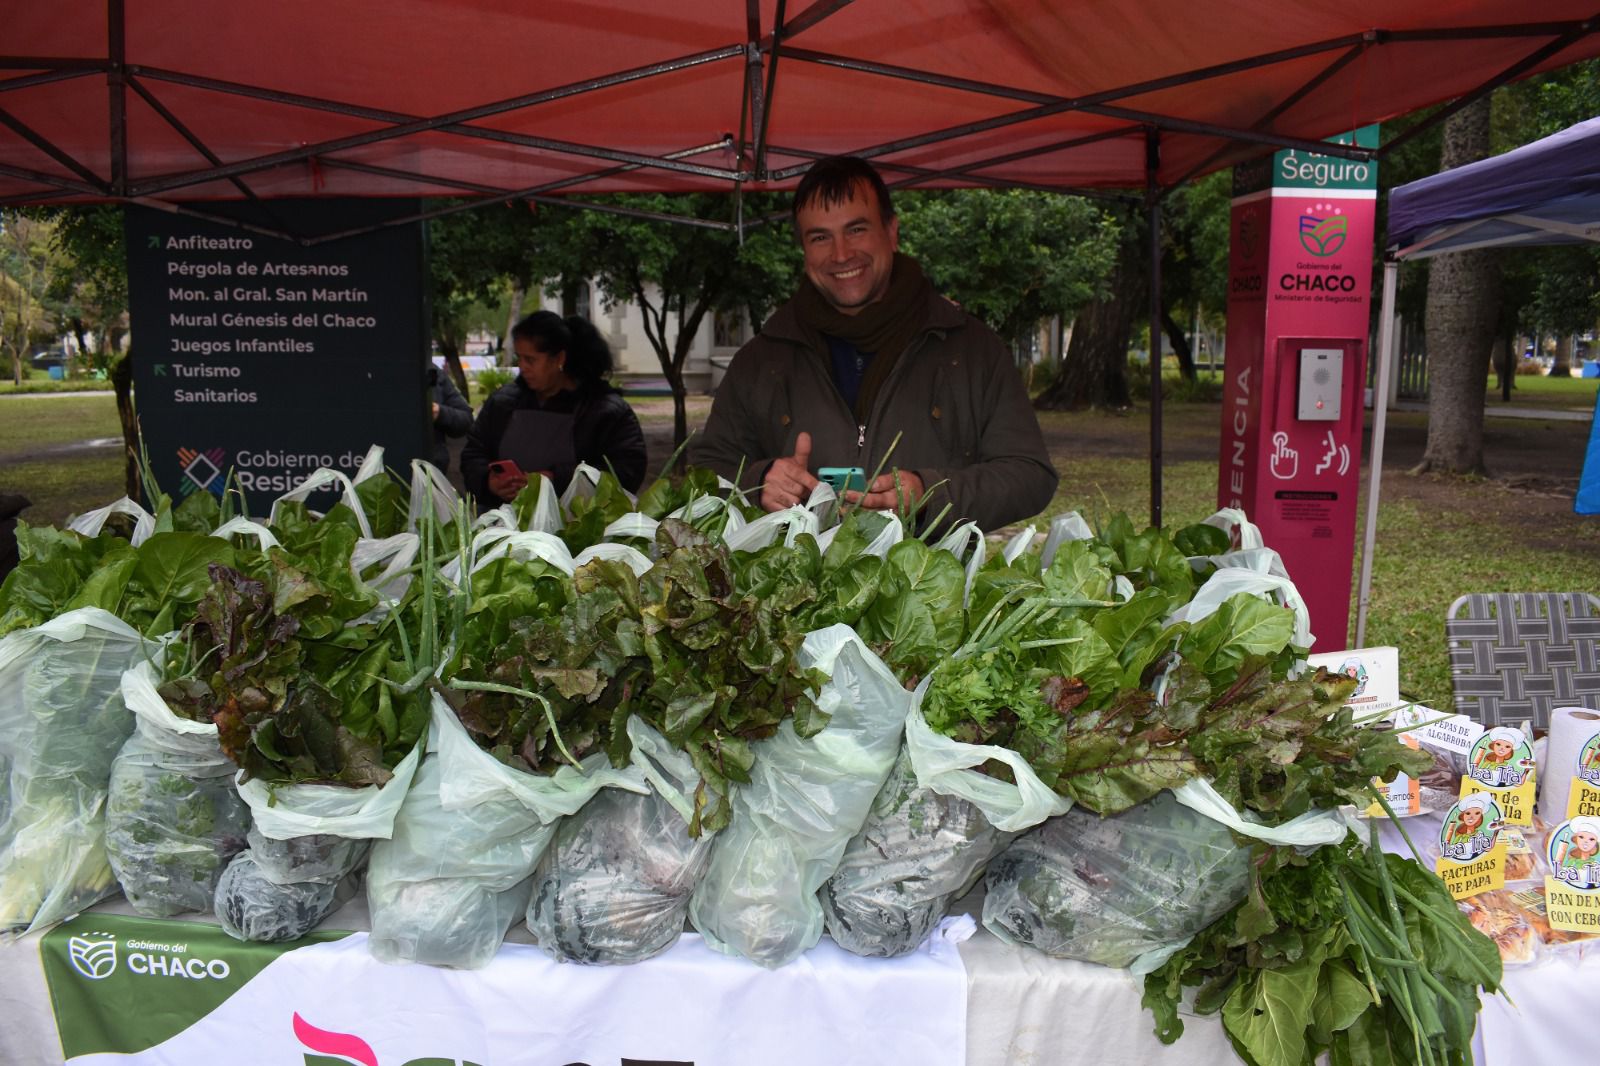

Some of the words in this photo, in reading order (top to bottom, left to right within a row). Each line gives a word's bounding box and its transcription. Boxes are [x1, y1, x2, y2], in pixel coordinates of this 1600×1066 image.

[1282, 157, 1368, 186] Seguro
[166, 236, 253, 249] Anfiteatro
[167, 261, 232, 278] Pérgola
[236, 262, 258, 276] de
[262, 262, 349, 276] Artesanos
[1296, 262, 1329, 270] Gobierno
[1280, 273, 1356, 292] CHACO
[168, 287, 209, 301] Mon.
[213, 287, 228, 301] al
[232, 287, 272, 301] Gral.
[275, 288, 307, 301] San
[312, 287, 368, 302] Martín
[1274, 294, 1312, 302] Ministerio
[1325, 295, 1362, 304] Seguridad
[169, 313, 217, 327] Mural
[221, 312, 288, 327] Génesis
[291, 313, 318, 327] del
[322, 313, 377, 328] Chaco
[170, 338, 231, 355] Juegos
[235, 338, 315, 352] Infantiles
[172, 363, 241, 377] Turismo
[174, 388, 258, 402] Sanitarios
[236, 450, 333, 468] Gobierno
[1427, 728, 1472, 749] ALGARROBA
[1458, 726, 1470, 737] DE
[1470, 763, 1492, 780] La
[1502, 791, 1520, 805] de
[1580, 788, 1600, 802] Pa
[1442, 841, 1466, 857] La
[1442, 859, 1496, 881] FACTURAS
[1552, 860, 1580, 881] La
[1448, 882, 1463, 894] DE
[1465, 875, 1492, 891] PAPA
[1550, 893, 1573, 906] PAN
[1576, 894, 1592, 908] DE
[1550, 910, 1573, 924] CON
[126, 939, 169, 952] Gobierno
[171, 943, 188, 953] del
[127, 952, 231, 980] CHACO
